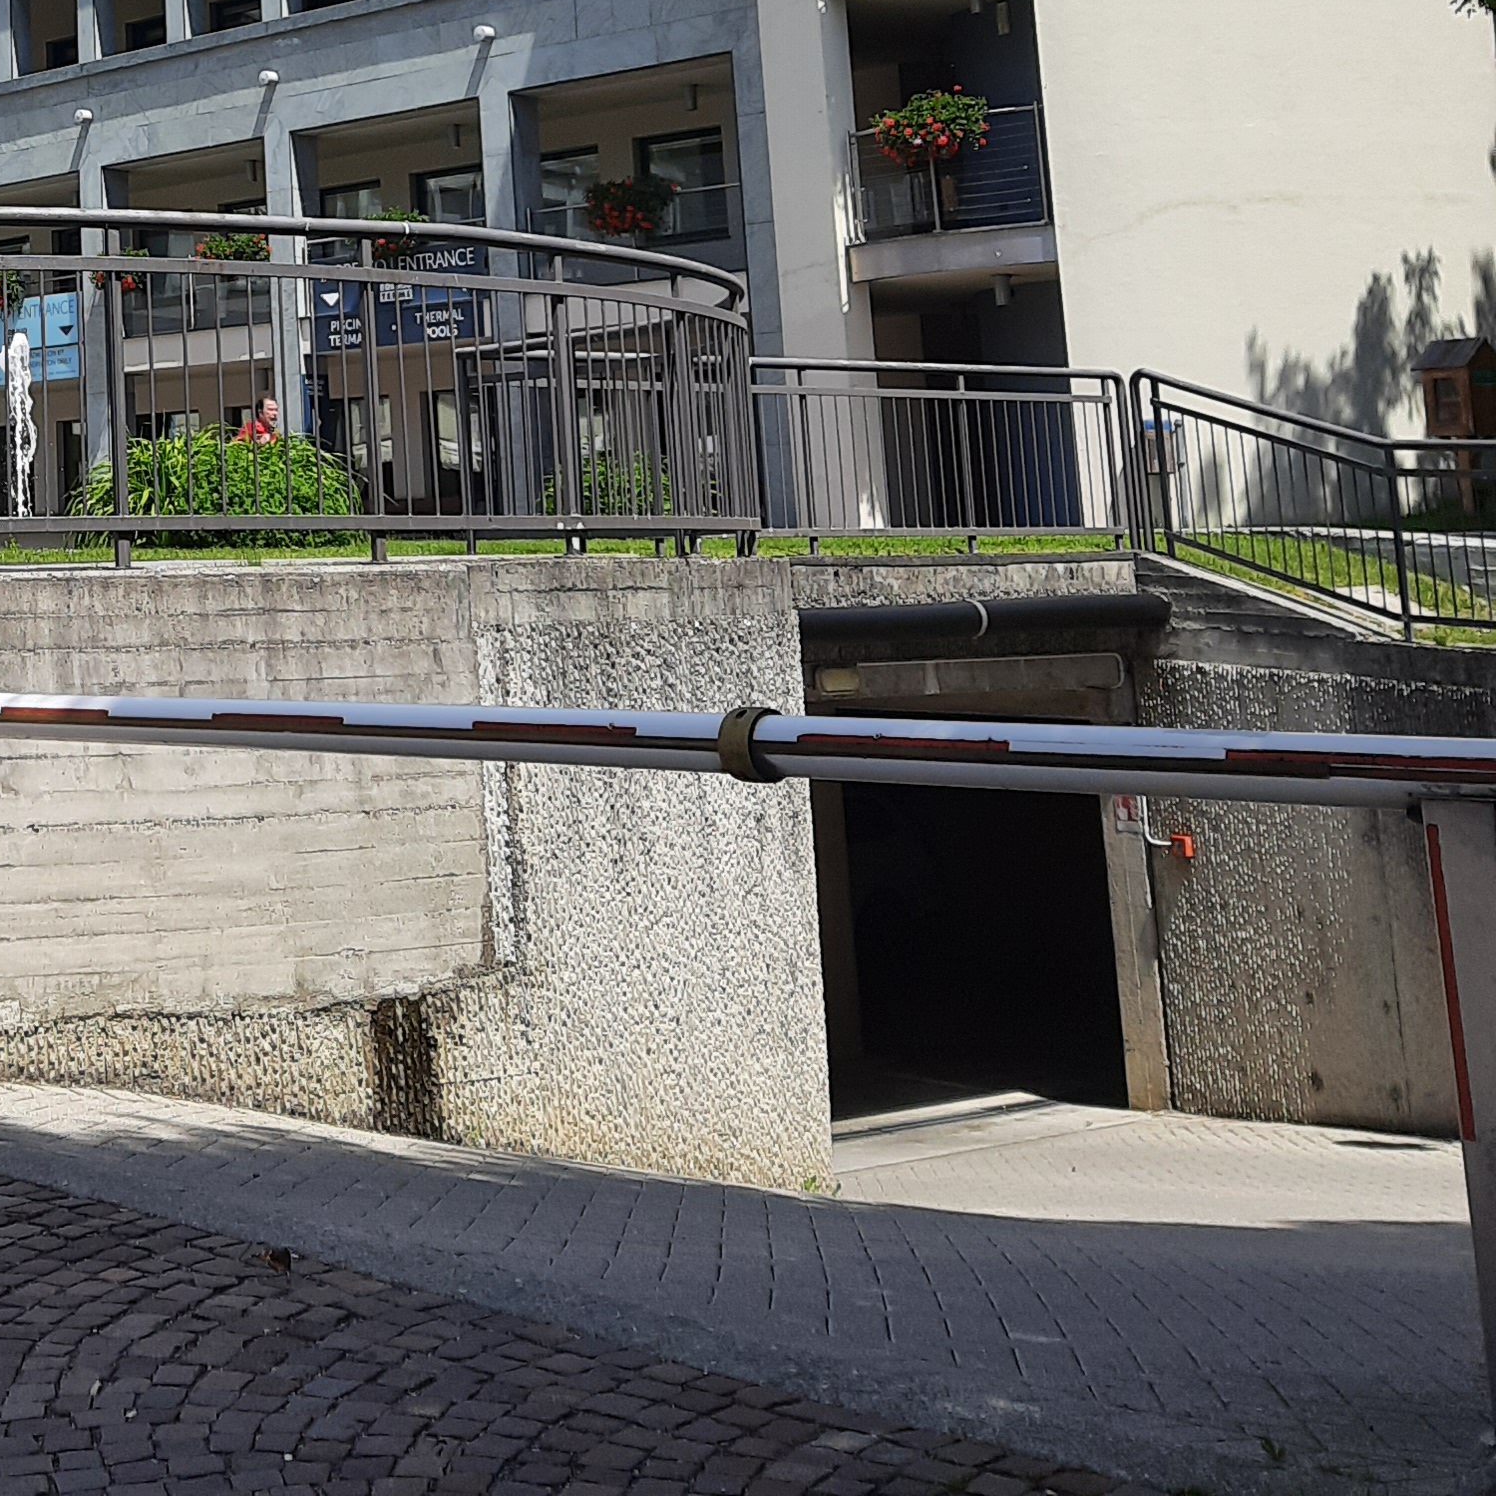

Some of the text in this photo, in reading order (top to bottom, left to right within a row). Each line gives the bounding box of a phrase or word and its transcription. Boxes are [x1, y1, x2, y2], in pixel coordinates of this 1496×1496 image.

[398, 247, 475, 271] ENTRANCE
[330, 318, 362, 332] PISCIN
[328, 333, 362, 347] TERMA
